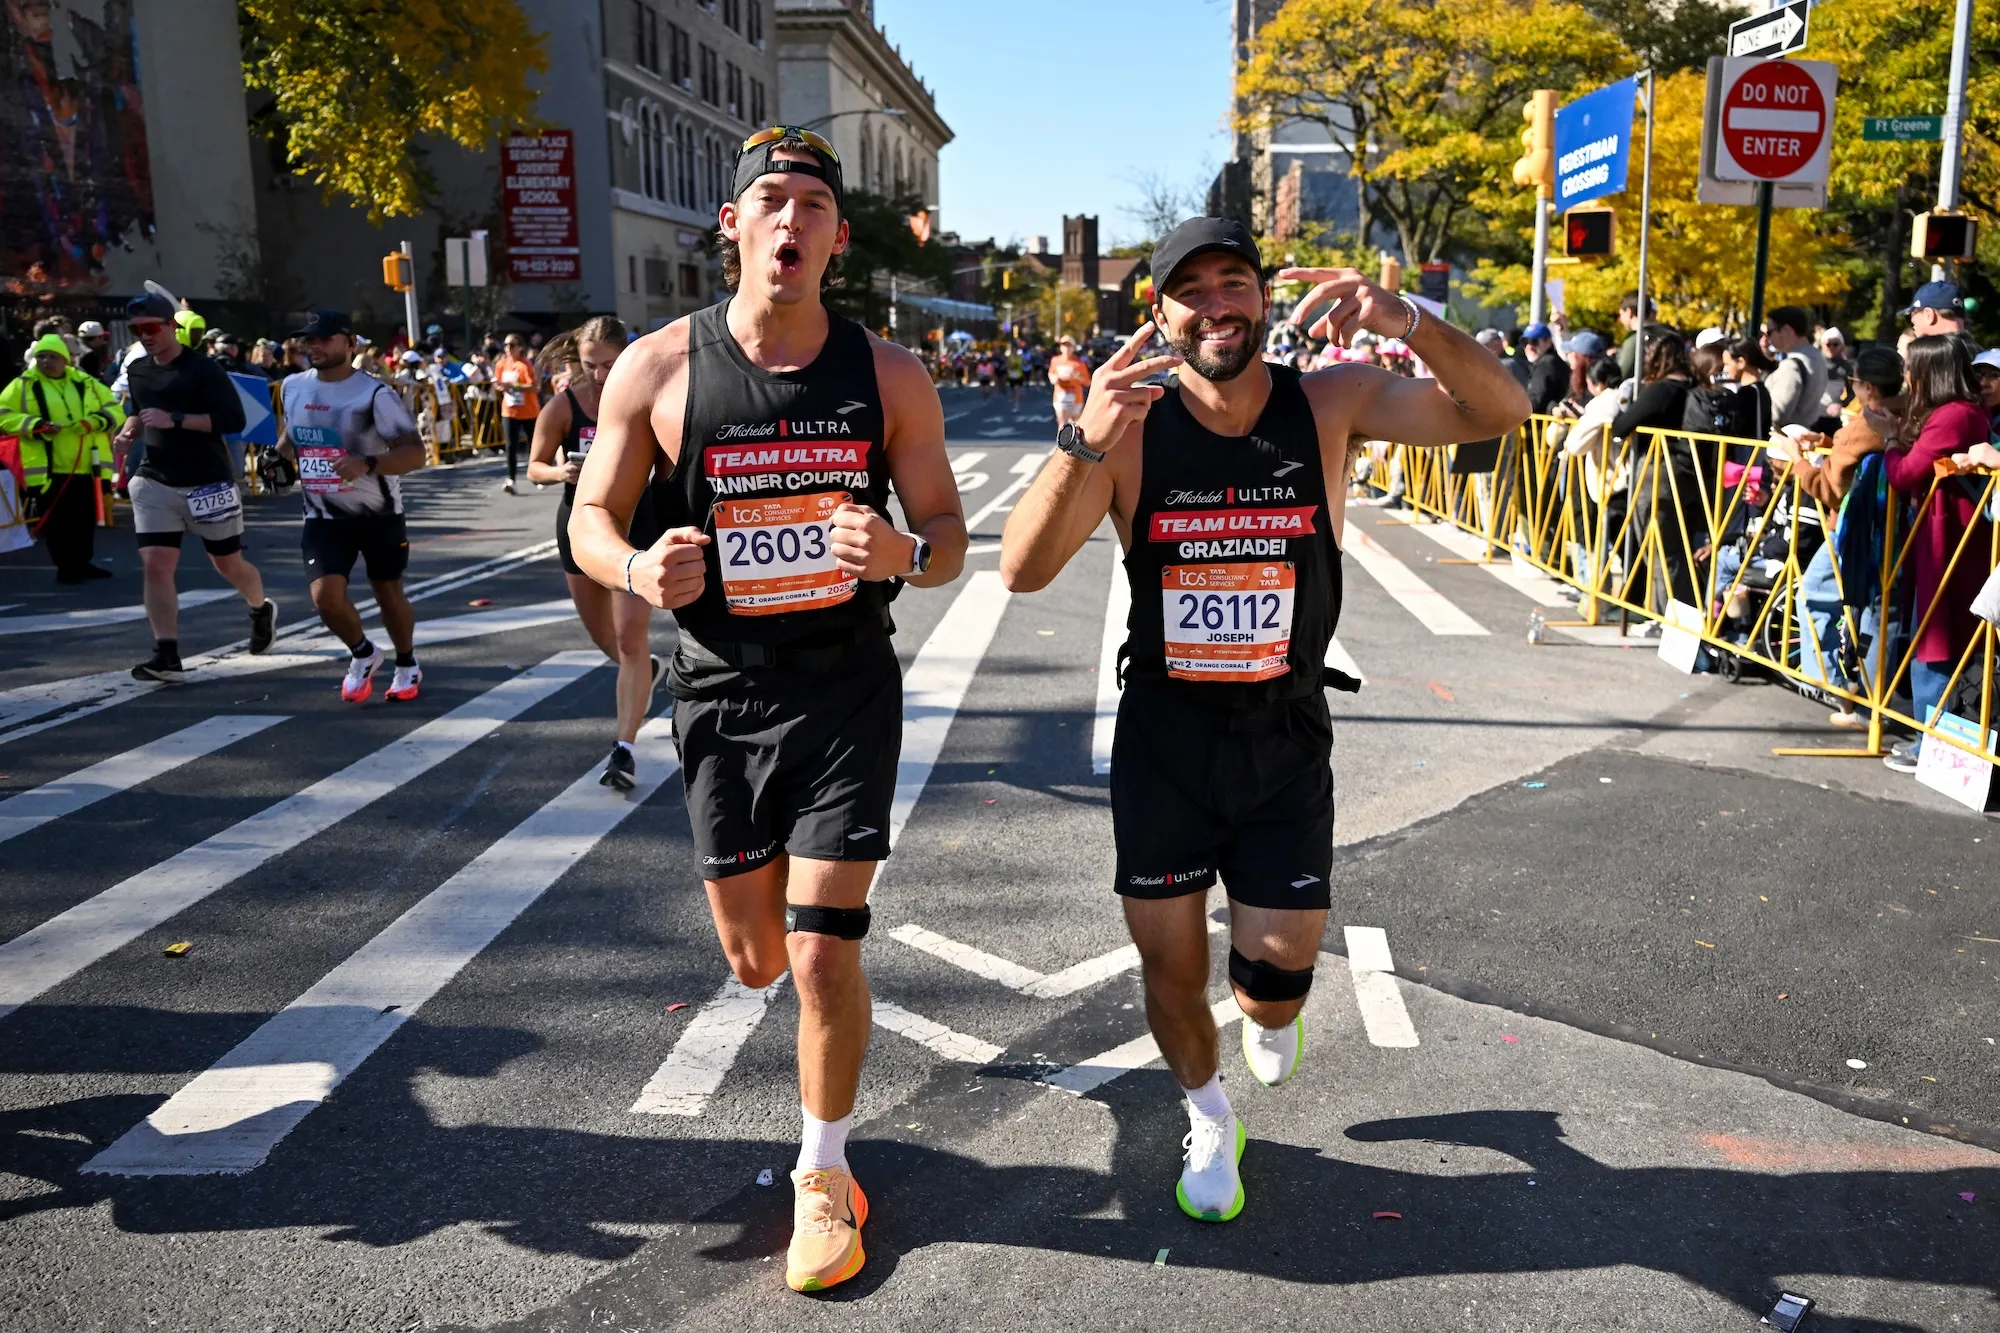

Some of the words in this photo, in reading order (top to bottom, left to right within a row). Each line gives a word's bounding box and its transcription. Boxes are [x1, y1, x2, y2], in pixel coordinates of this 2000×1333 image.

[1740, 31, 1760, 52] ONE
[1771, 20, 1794, 41] WAY
[1742, 83, 1767, 102] DO
[1774, 84, 1810, 104] NOT
[1875, 119, 1888, 132] Ft
[1891, 119, 1932, 132] Greene
[1558, 134, 1618, 176] PEDESTRIAN
[1743, 136, 1801, 157] ENTER
[506, 176, 571, 189] ELEMENTARY
[1562, 163, 1609, 198] CROSSING
[519, 191, 561, 204] SCHOOL
[296, 428, 324, 443] OSCAR
[716, 422, 777, 440] Michelob
[792, 421, 851, 434] ULTRA
[712, 450, 779, 468] TEAM
[784, 448, 858, 463] ULTRA
[706, 473, 783, 495] TANNER
[786, 470, 869, 490] COURTAD
[193, 490, 234, 511] 21783
[1165, 489, 1224, 505] Michelob
[1239, 486, 1297, 501] ULTRA
[732, 506, 763, 524] tcs
[764, 507, 806, 516] CONSULTANCY
[1159, 516, 1226, 532] TEAM
[1229, 515, 1302, 530] ULTRA
[726, 525, 837, 566] 2603
[1179, 538, 1287, 559] GRAZIADEI
[1179, 569, 1207, 586] tcs
[827, 583, 850, 595] 2025
[748, 596, 755, 605] 2
[1178, 593, 1280, 630] 26112
[1207, 633, 1254, 642] JOSEPH
[1261, 657, 1279, 668] 2025
[702, 854, 738, 865] Michelob
[1129, 875, 1164, 885] Michelob
[1174, 867, 1208, 883] ULTRA
